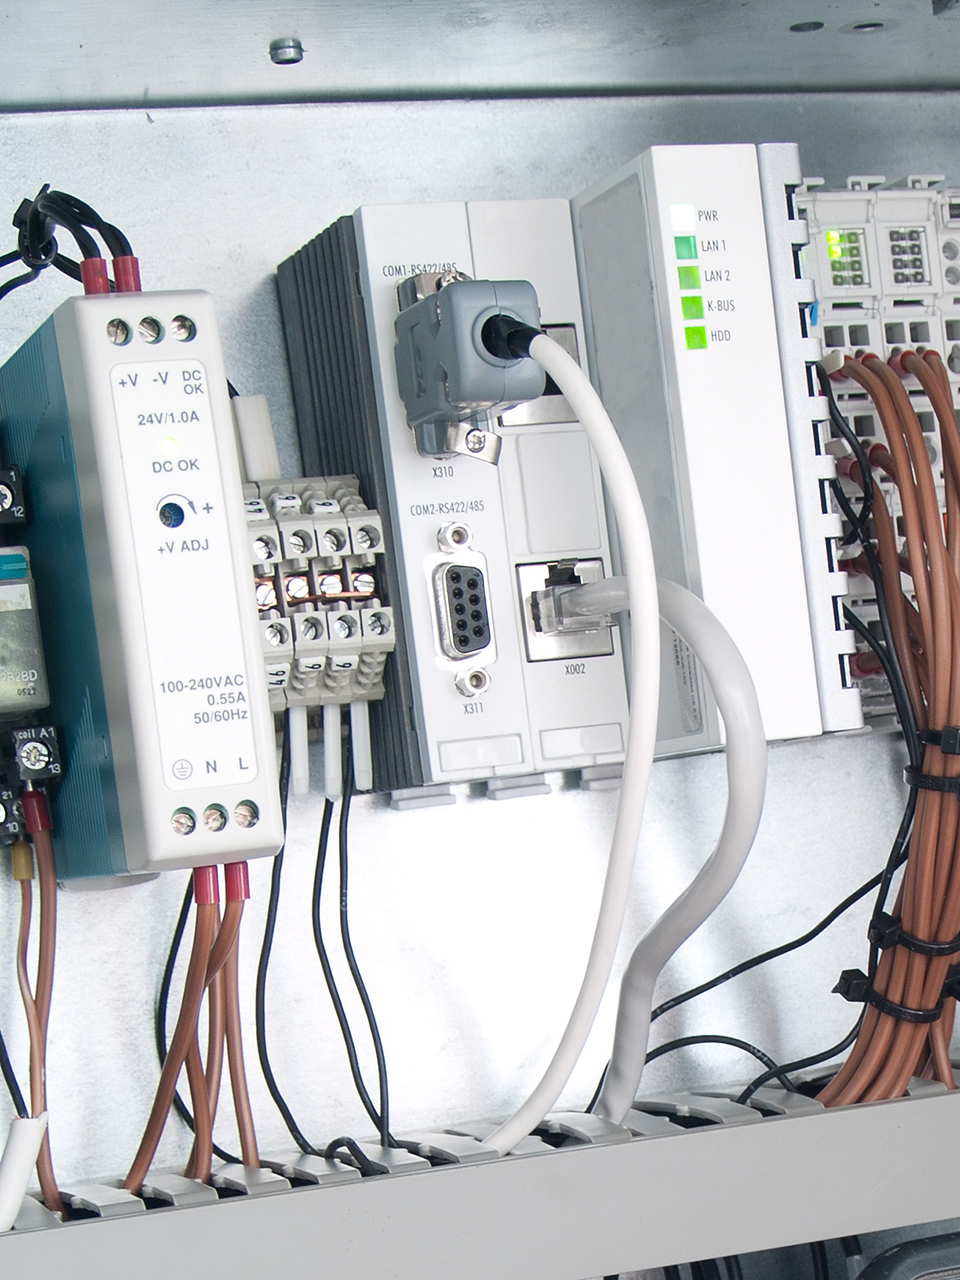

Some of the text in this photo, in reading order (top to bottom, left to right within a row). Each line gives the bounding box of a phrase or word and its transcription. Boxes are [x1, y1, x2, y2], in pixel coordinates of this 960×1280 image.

[698, 210, 718, 221] PWR
[701, 240, 718, 252] LAN
[704, 270, 730, 282] LAN 2
[707, 299, 735, 312] K-BUS
[711, 330, 731, 342] HDD
[118, 370, 201, 388] +V -V DC
[183, 383, 204, 395] OK
[137, 410, 200, 426] 24V/1.0A
[152, 458, 200, 474] DC OK
[432, 465, 454, 478] X310
[11, 505, 25, 518] 12
[410, 500, 485, 517] COM2-RS422/485
[157, 538, 210, 555] +V ADJ
[565, 664, 586, 676] X002
[160, 674, 244, 693] 100-240VAC
[207, 690, 247, 706] 0.55A
[463, 702, 484, 715] X311
[194, 708, 248, 724] 50/60Hz
[18, 726, 55, 740] coil A1
[48, 764, 61, 774] 13
[205, 757, 249, 774] N L
[6, 822, 19, 832] 10
